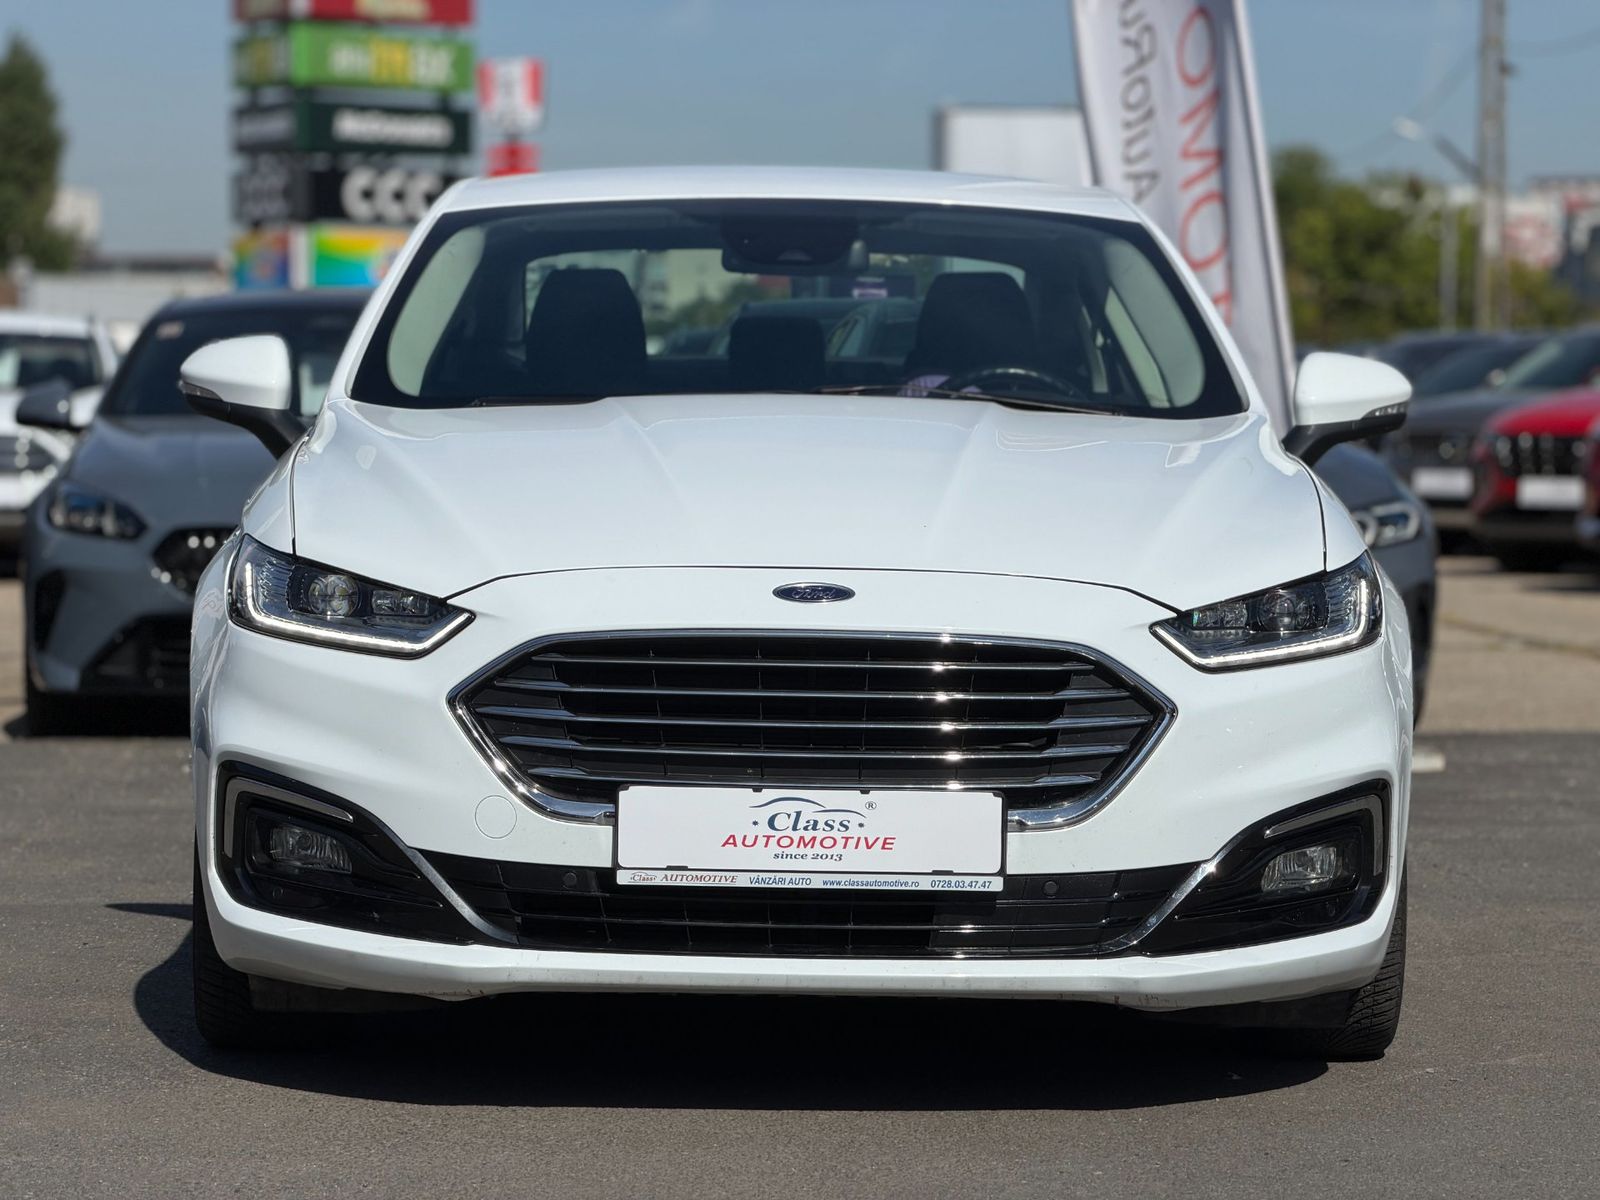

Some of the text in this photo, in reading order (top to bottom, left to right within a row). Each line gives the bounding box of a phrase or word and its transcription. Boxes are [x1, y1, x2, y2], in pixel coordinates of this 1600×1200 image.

[767, 810, 851, 832] Class
[721, 834, 896, 851] AUTOMOTIVE
[773, 851, 843, 862] since 2013
[660, 873, 738, 884] AUTOMOTIVE
[749, 874, 786, 886] VÂNZĂRI
[787, 876, 812, 886] AUTO
[822, 878, 920, 889] www.classautomotive.ro
[930, 879, 992, 889] 0728.03.47.47
